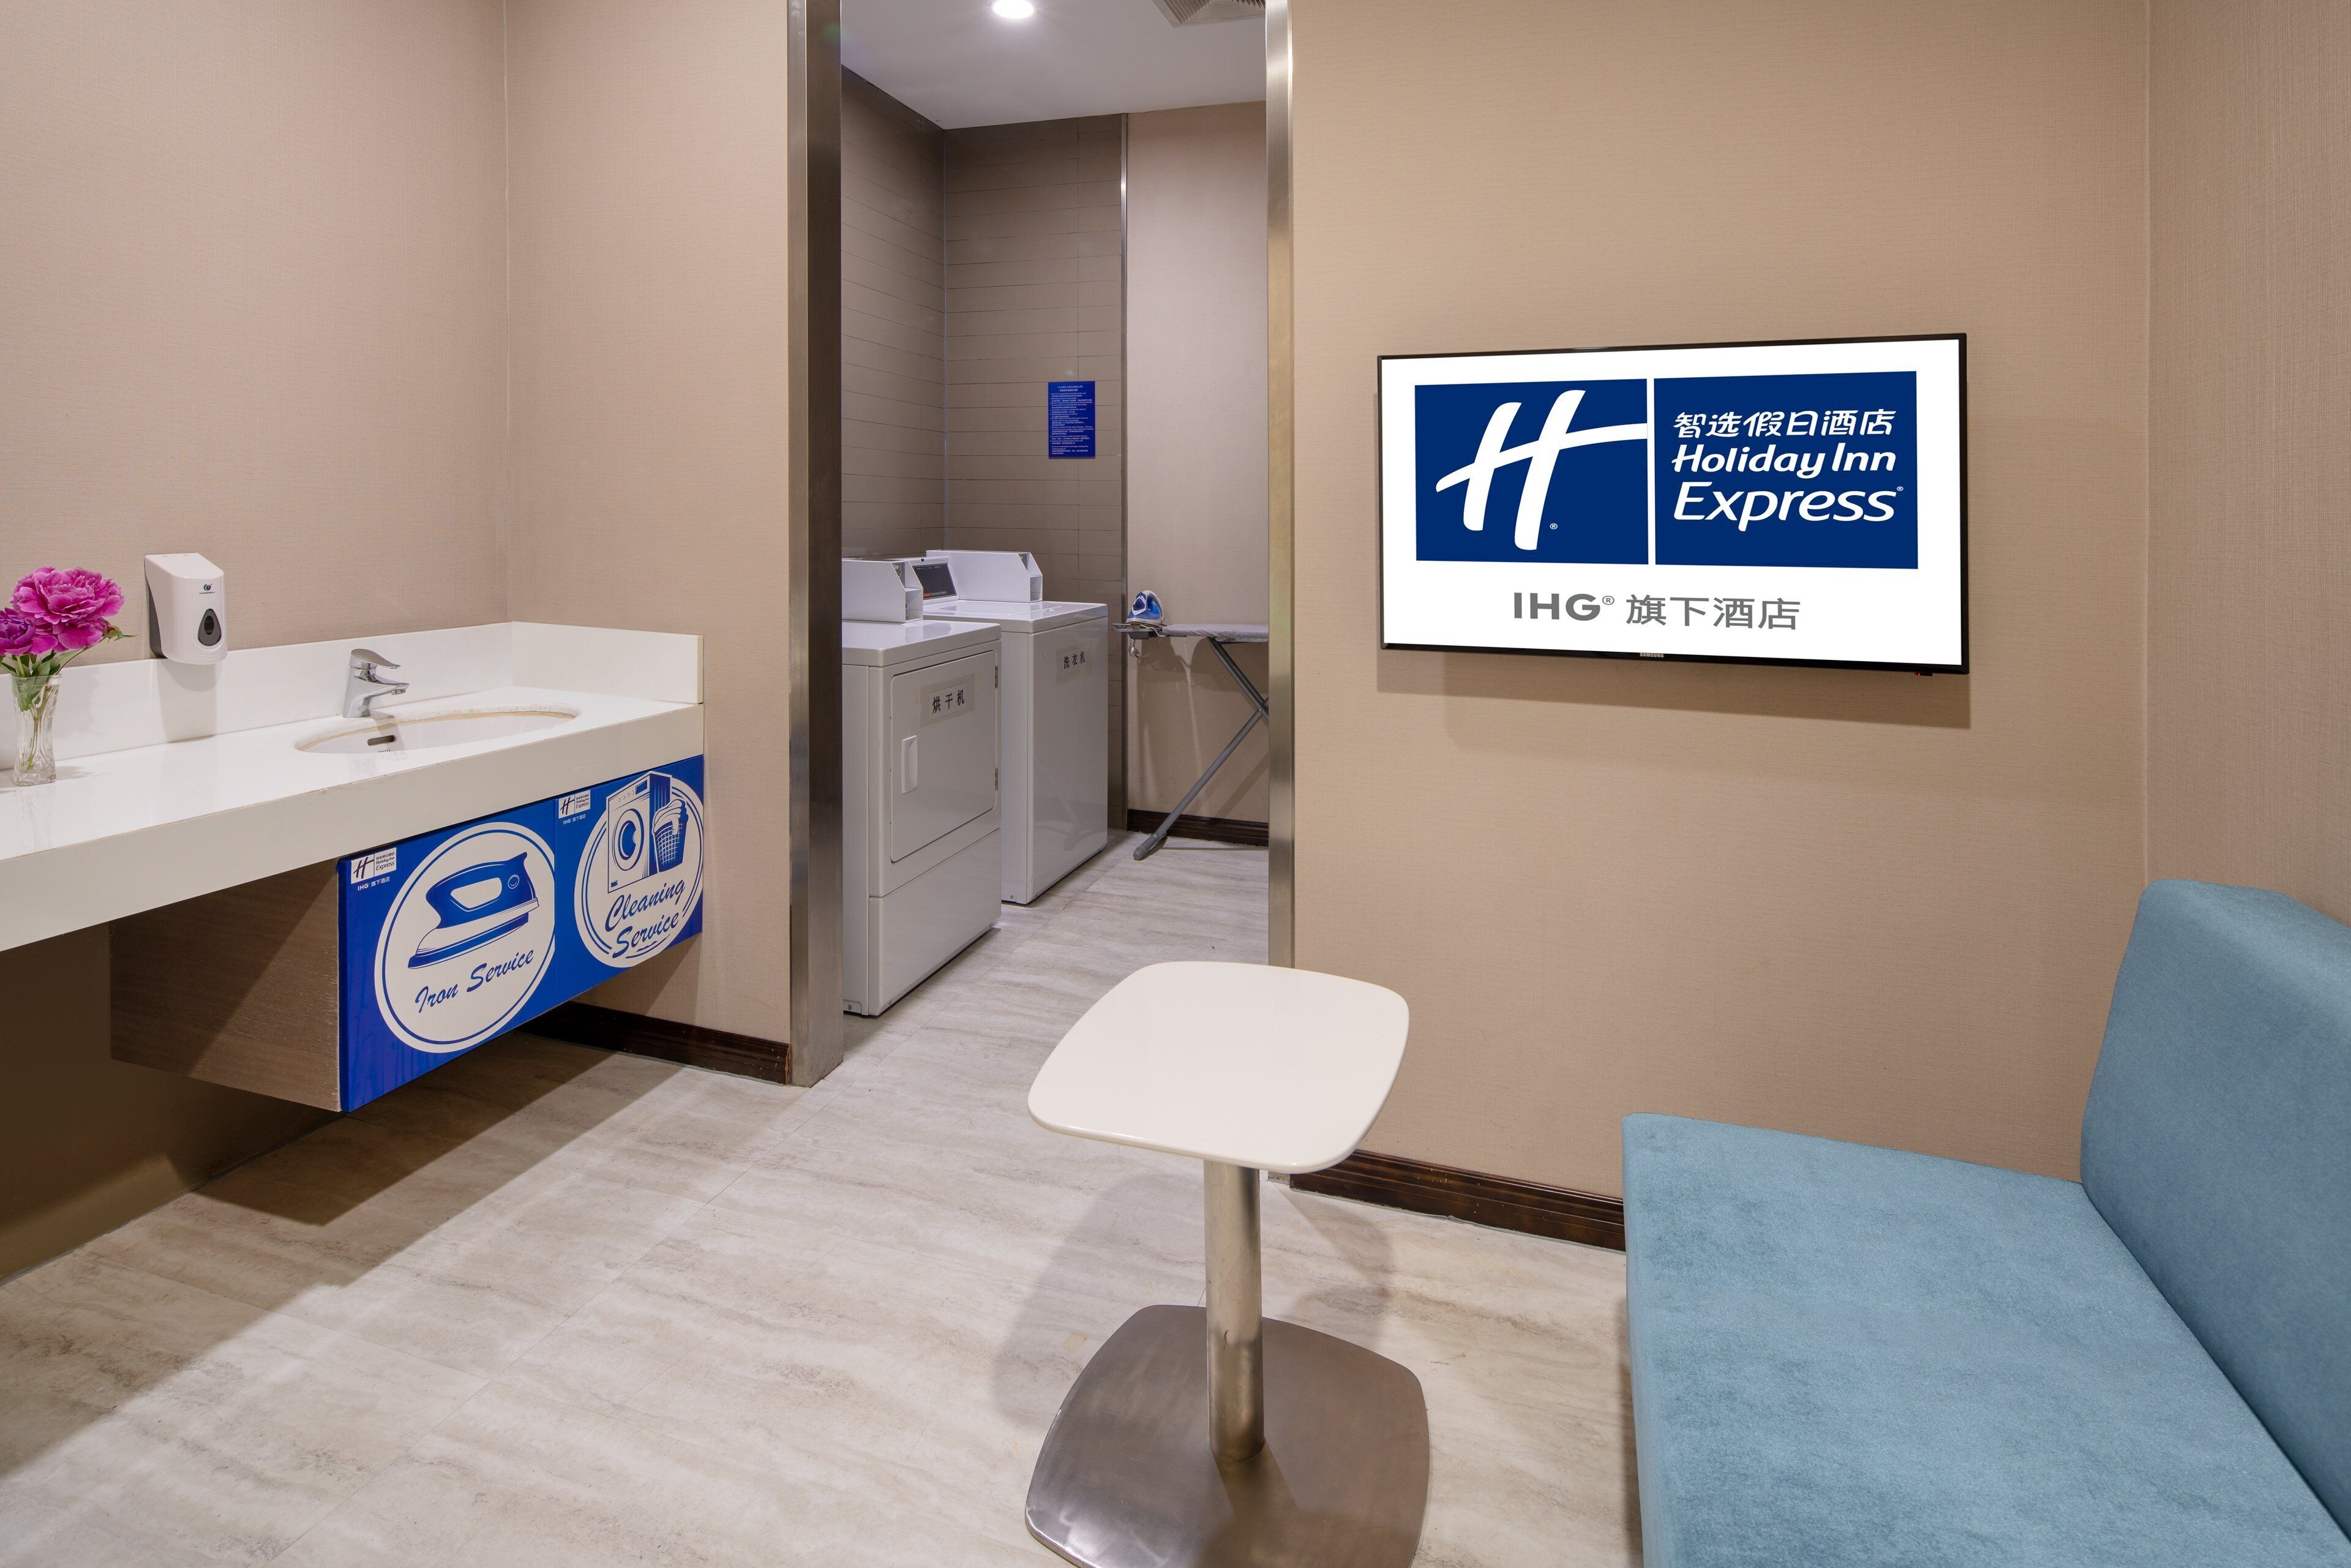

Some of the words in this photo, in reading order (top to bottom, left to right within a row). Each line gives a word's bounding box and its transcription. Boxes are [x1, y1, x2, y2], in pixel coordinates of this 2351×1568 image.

[1673, 409, 1897, 439] 智选假日酒店
[1671, 443, 1826, 479] Holiday
[1831, 442, 1897, 471] Inn
[1625, 594, 1801, 630] 旗下酒店
[1063, 651, 1086, 669] 洗衣机
[932, 689, 965, 715] 烘干机
[375, 861, 395, 871] Express
[604, 879, 686, 932] Cleaning
[612, 912, 679, 959] Service
[414, 983, 459, 1013] Iron
[466, 950, 534, 992] Service
